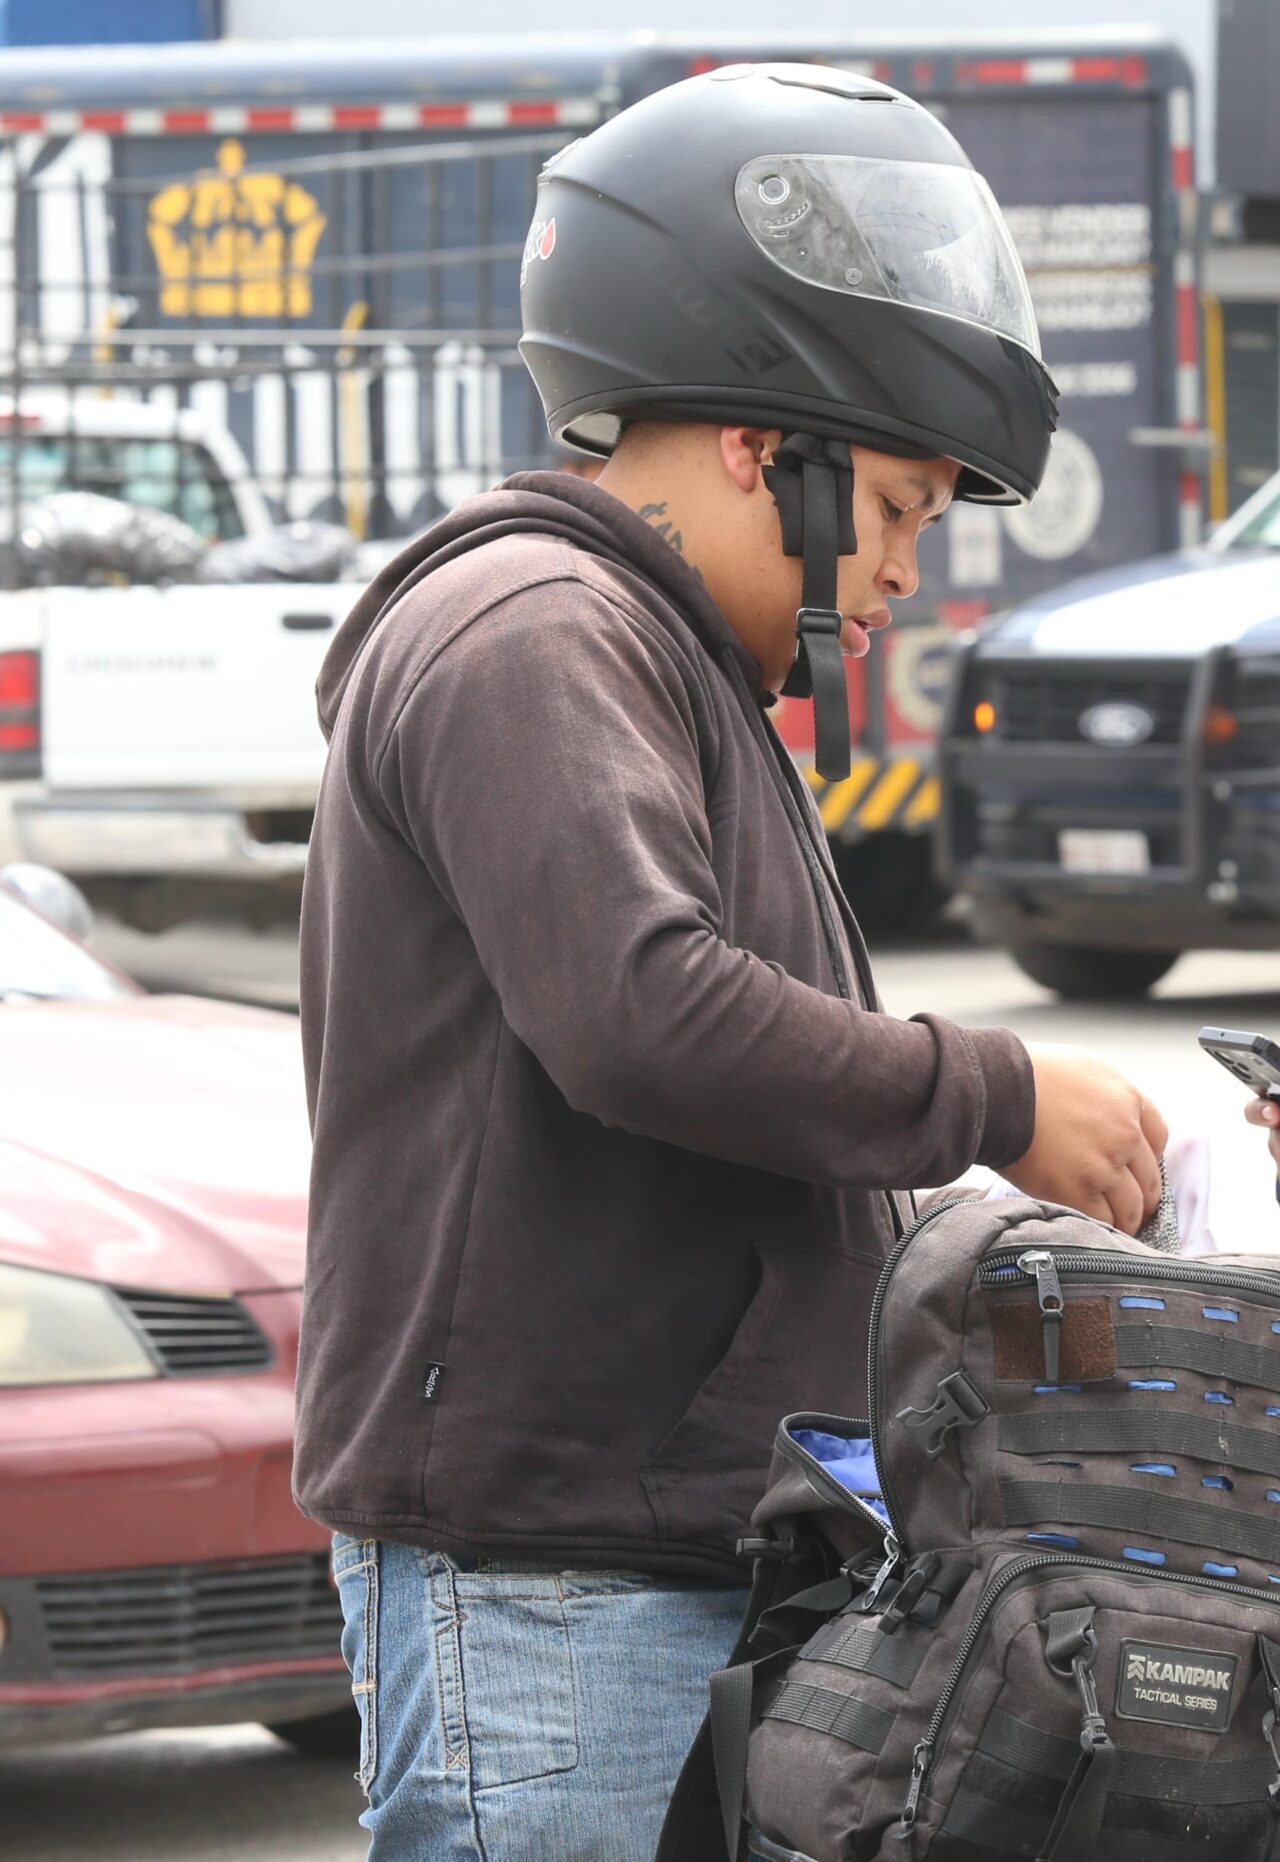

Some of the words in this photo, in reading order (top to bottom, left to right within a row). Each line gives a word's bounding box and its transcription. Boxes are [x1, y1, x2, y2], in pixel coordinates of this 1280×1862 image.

[1146, 1660, 1230, 1691] KAMPAK
[1134, 1687, 1182, 1706] TACTICAL
[1184, 1695, 1218, 1711] SERIES
